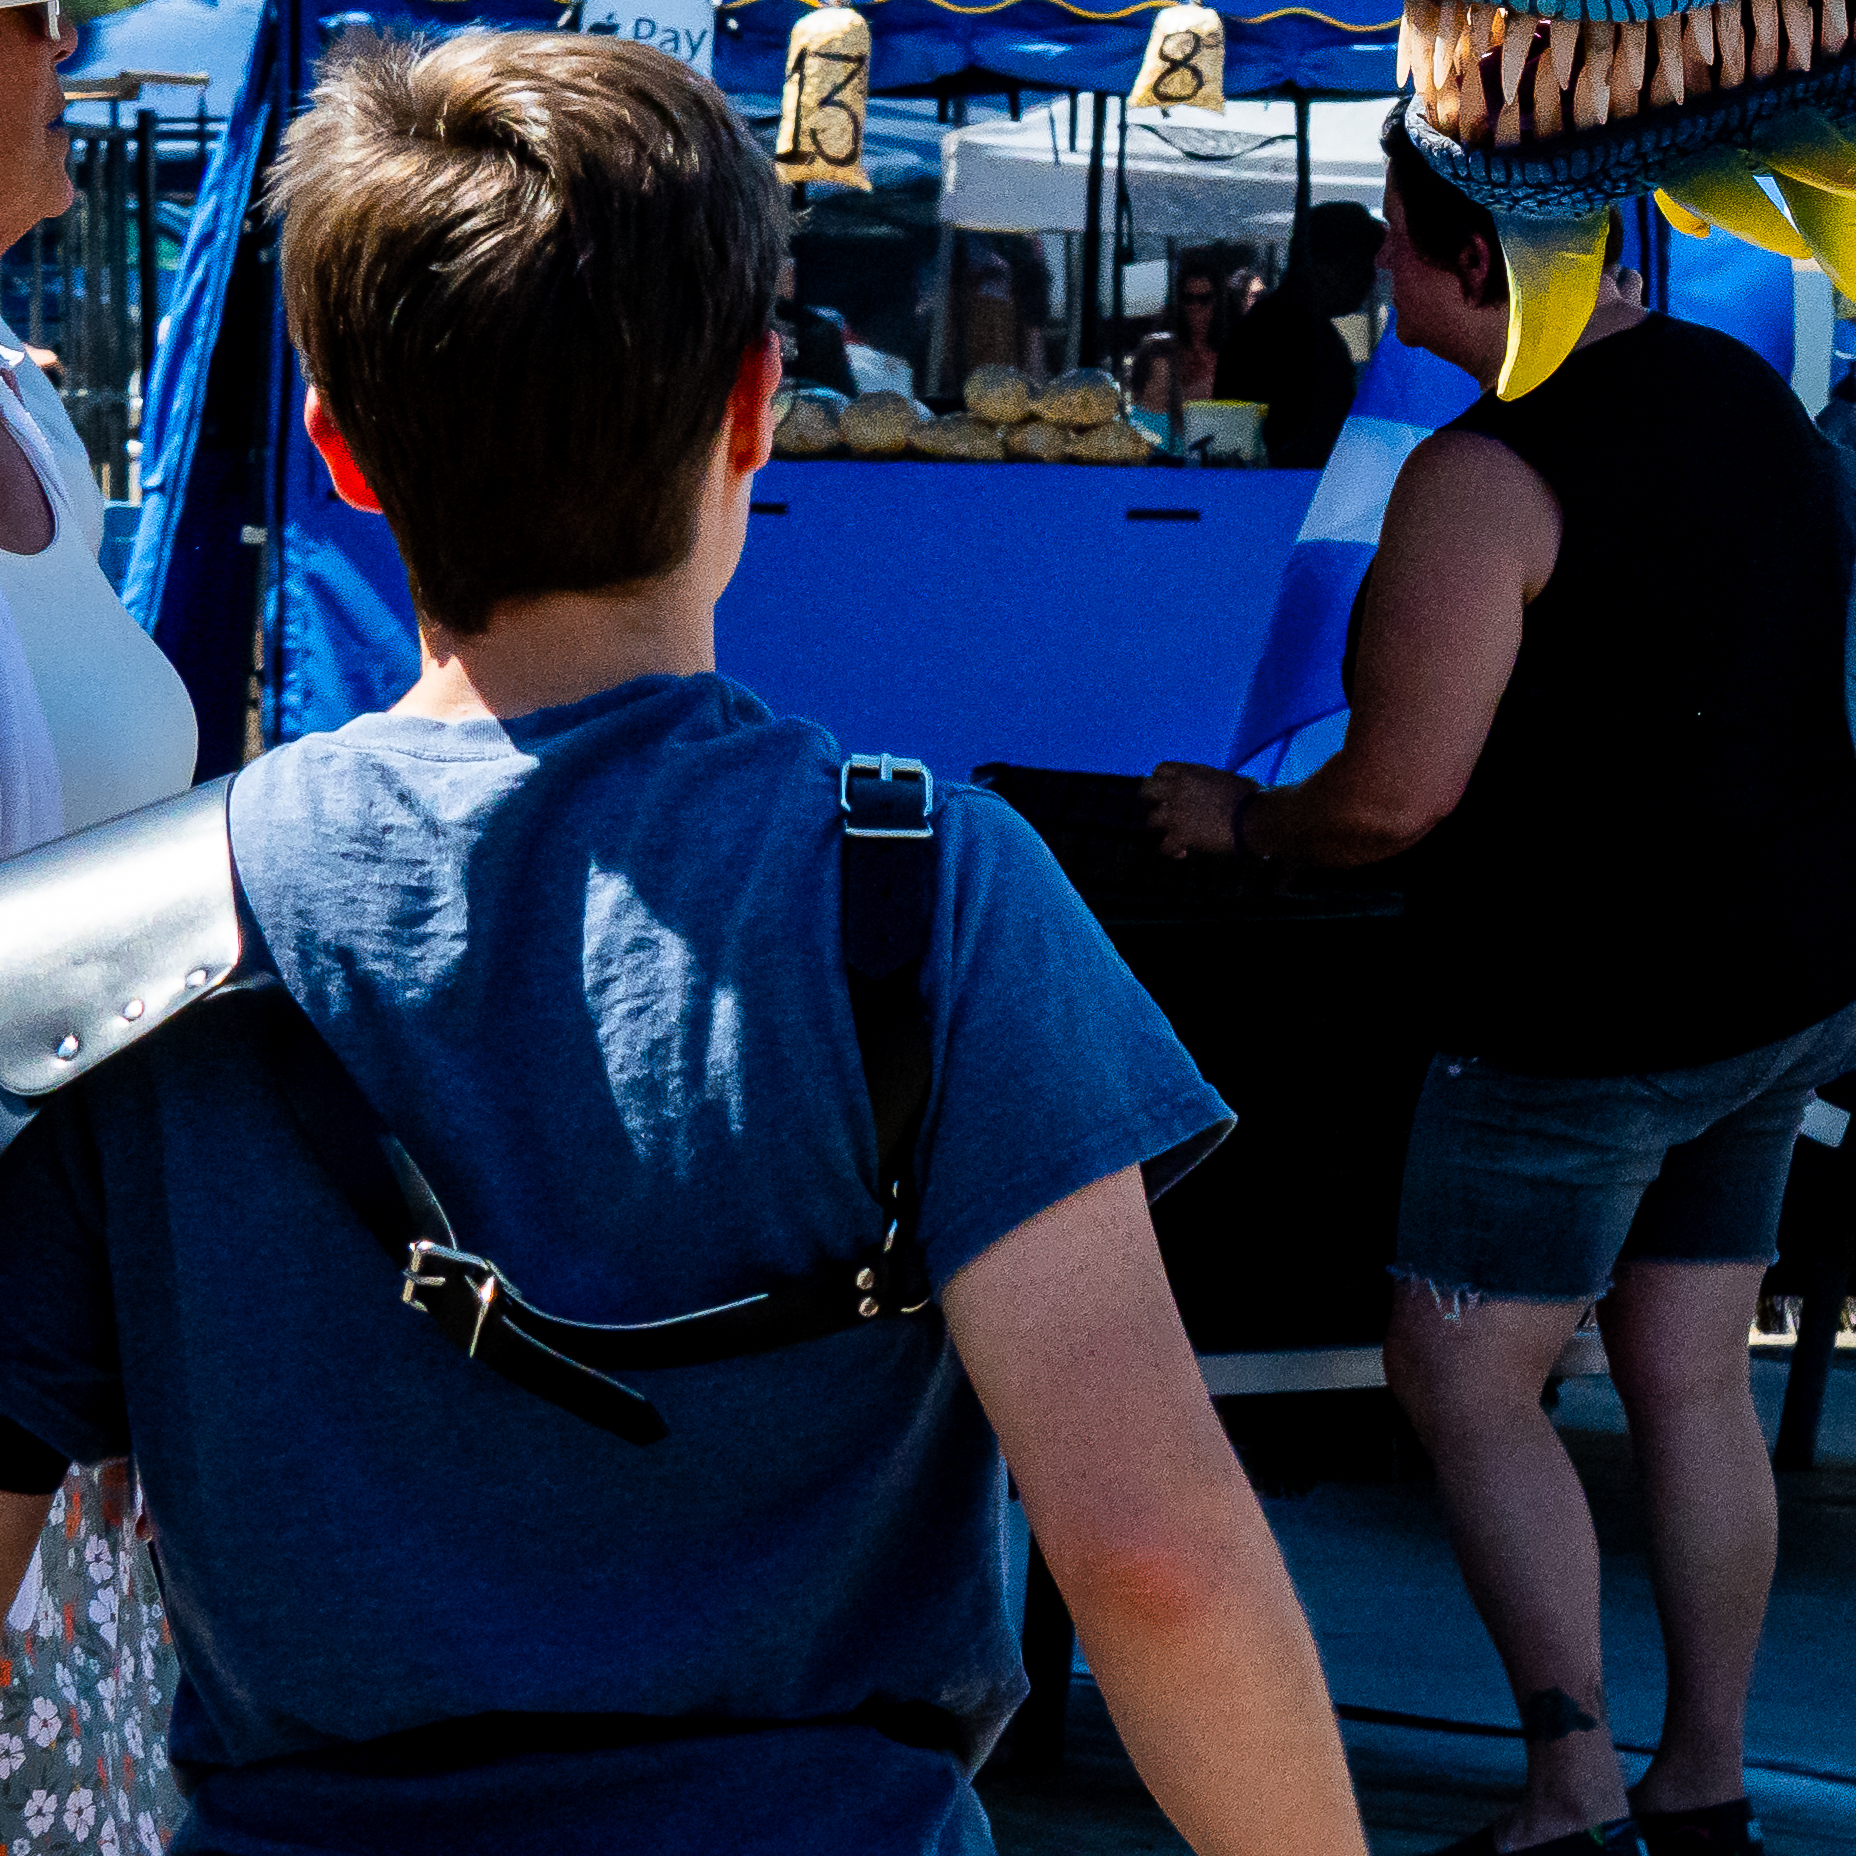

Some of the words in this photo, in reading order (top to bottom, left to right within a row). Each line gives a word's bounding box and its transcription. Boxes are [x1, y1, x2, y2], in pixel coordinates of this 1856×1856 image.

[633, 17, 708, 63] Pay
[1152, 29, 1204, 102] 8
[775, 47, 867, 167] 13
